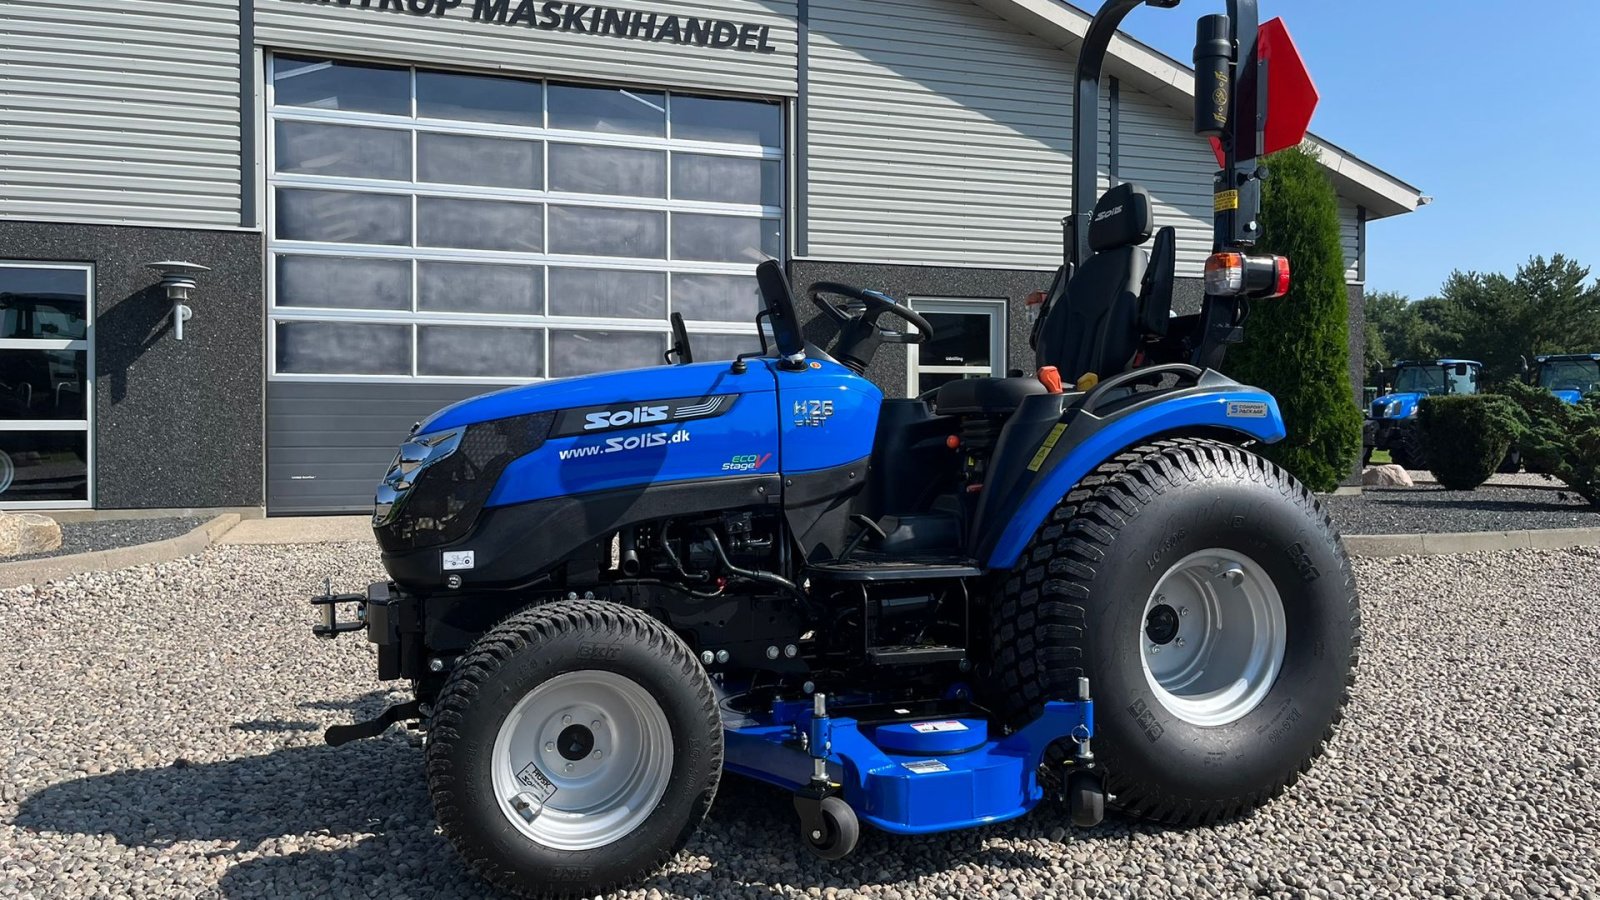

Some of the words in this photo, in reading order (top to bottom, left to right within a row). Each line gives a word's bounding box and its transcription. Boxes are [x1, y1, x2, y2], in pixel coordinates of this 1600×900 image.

[472, 0, 776, 52] MASKINHANDEL
[794, 400, 833, 416] H26
[532, 768, 551, 788] HUSK
